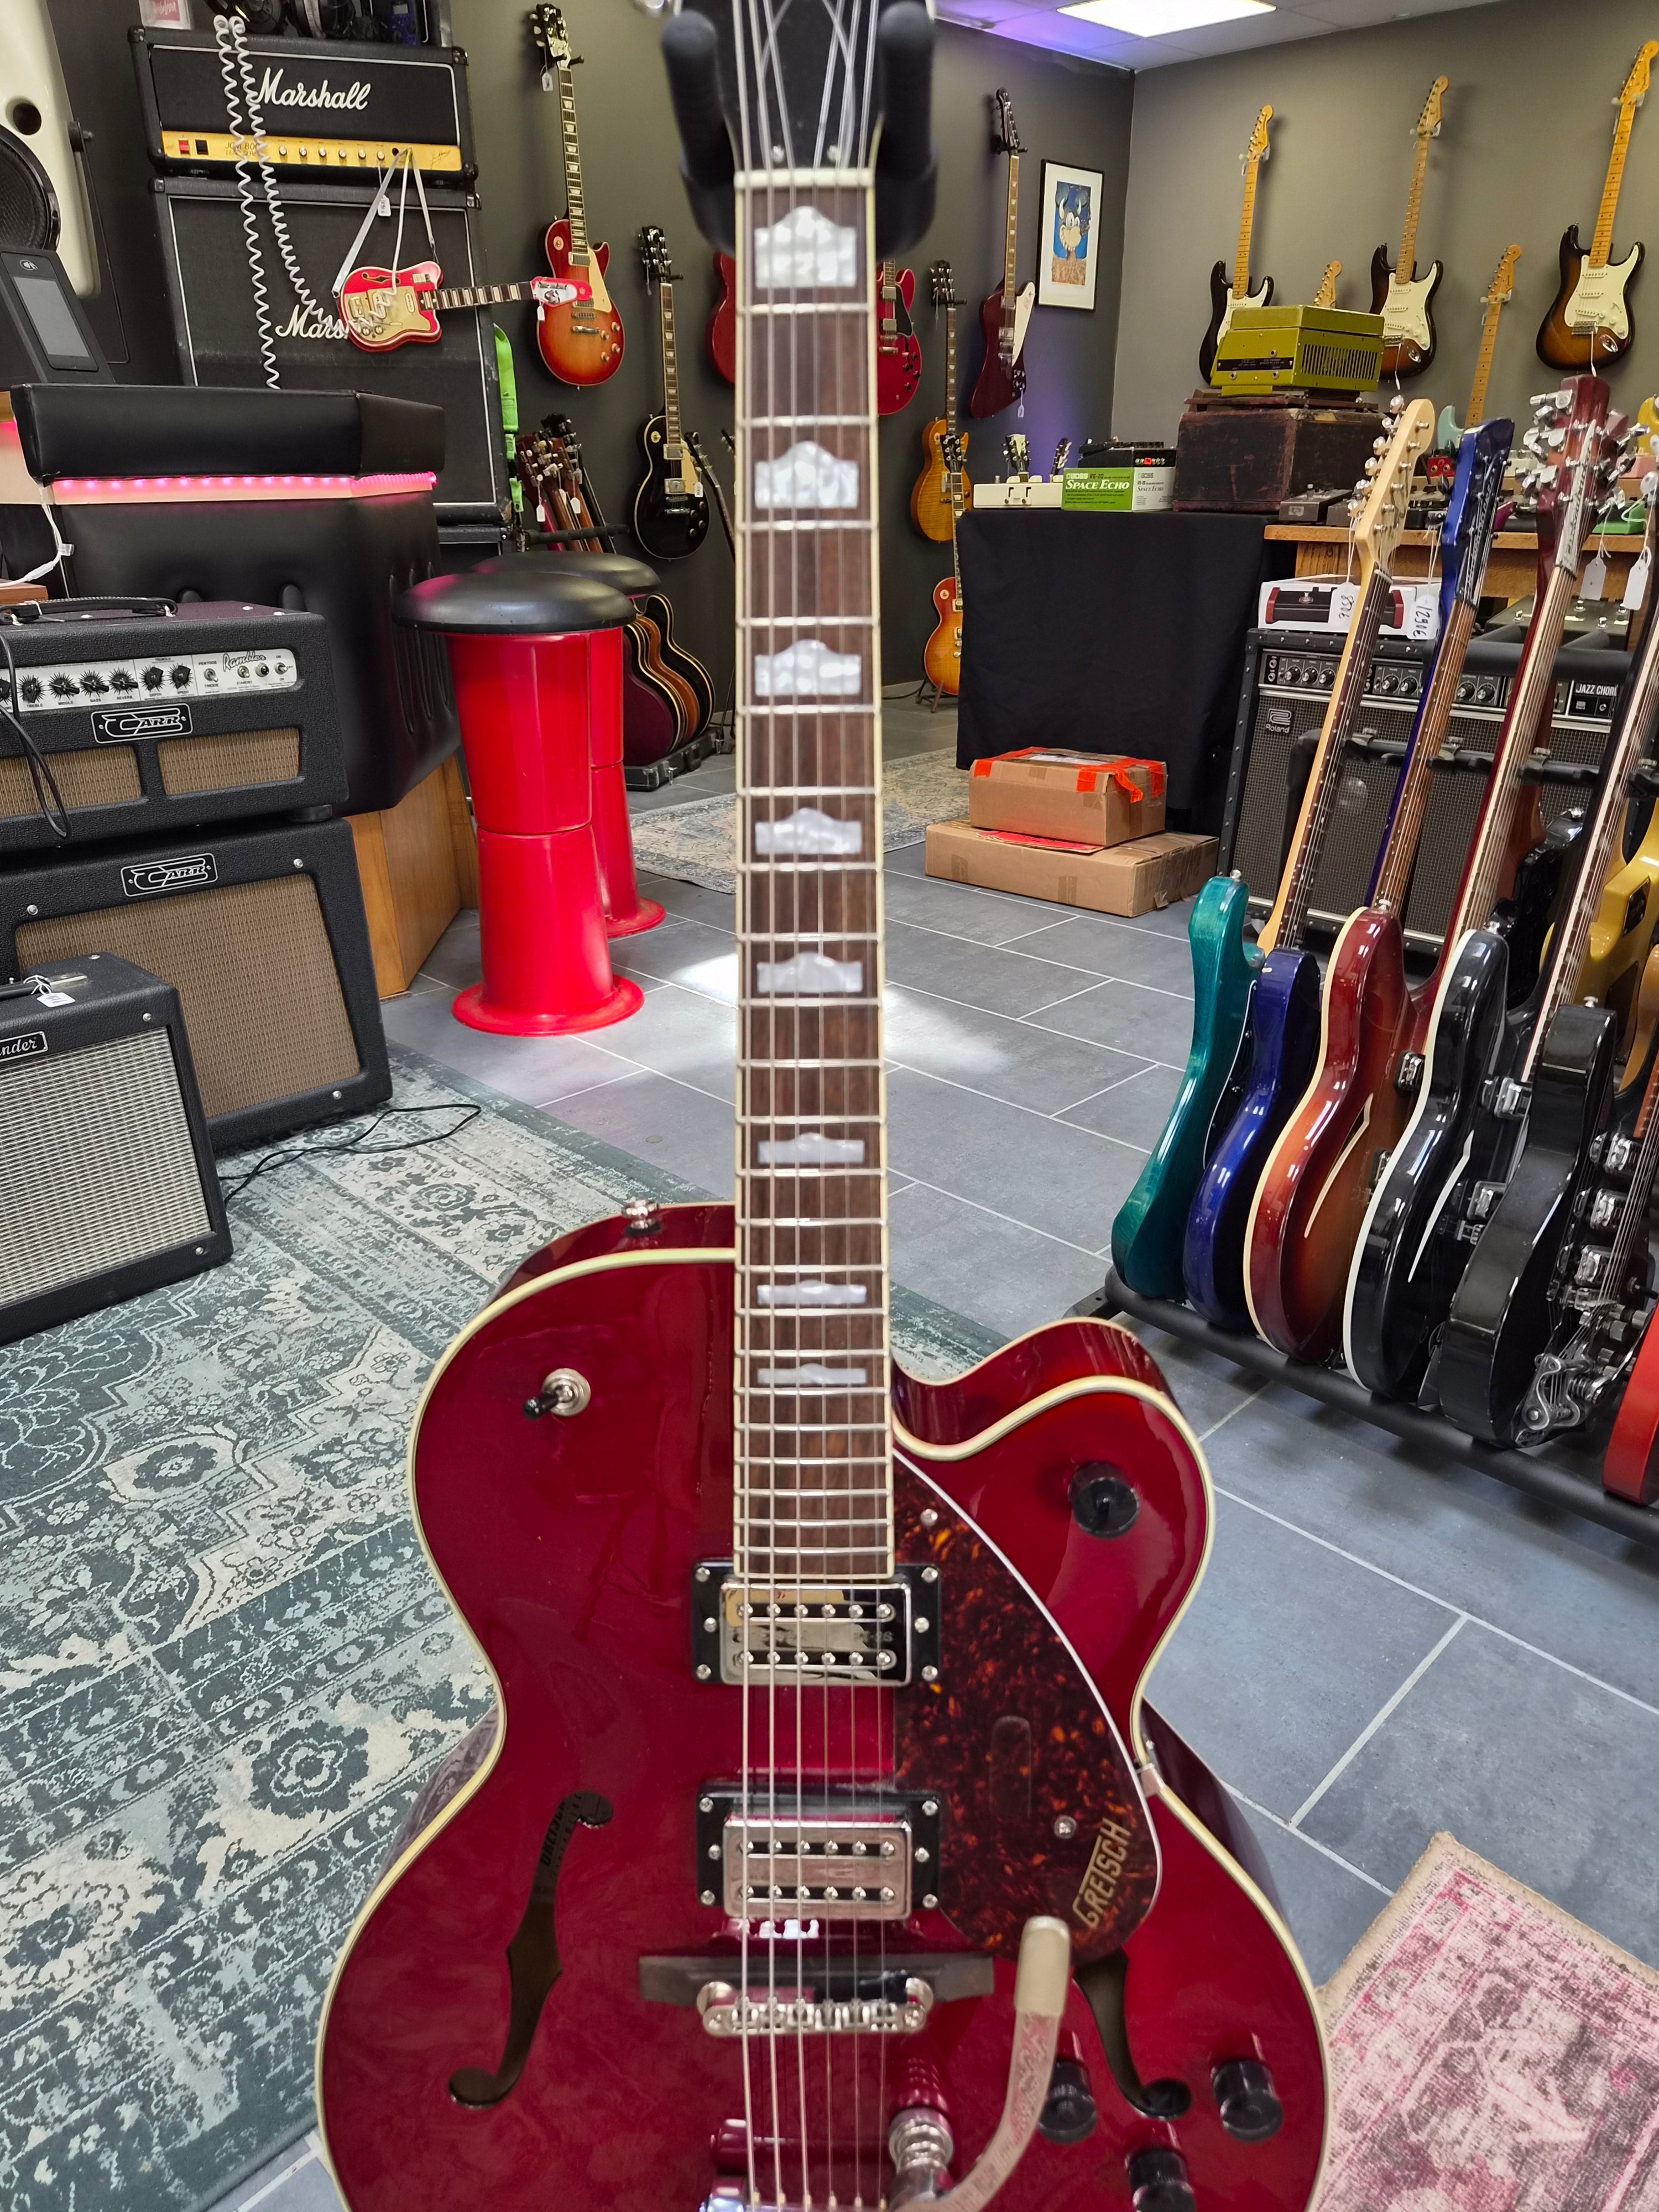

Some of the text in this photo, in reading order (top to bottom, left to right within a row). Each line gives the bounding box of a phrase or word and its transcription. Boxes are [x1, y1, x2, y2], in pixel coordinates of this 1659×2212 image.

[249, 67, 371, 110] Marshall
[1065, 479, 1099, 489] SPACE
[1099, 479, 1130, 489] ECHO
[223, 650, 267, 672] Rambler
[1575, 684, 1595, 694] JAZZ
[1266, 723, 1290, 733] Roland
[0, 1039, 37, 1056] nder
[1072, 1818, 1131, 1929] GRETSCH
